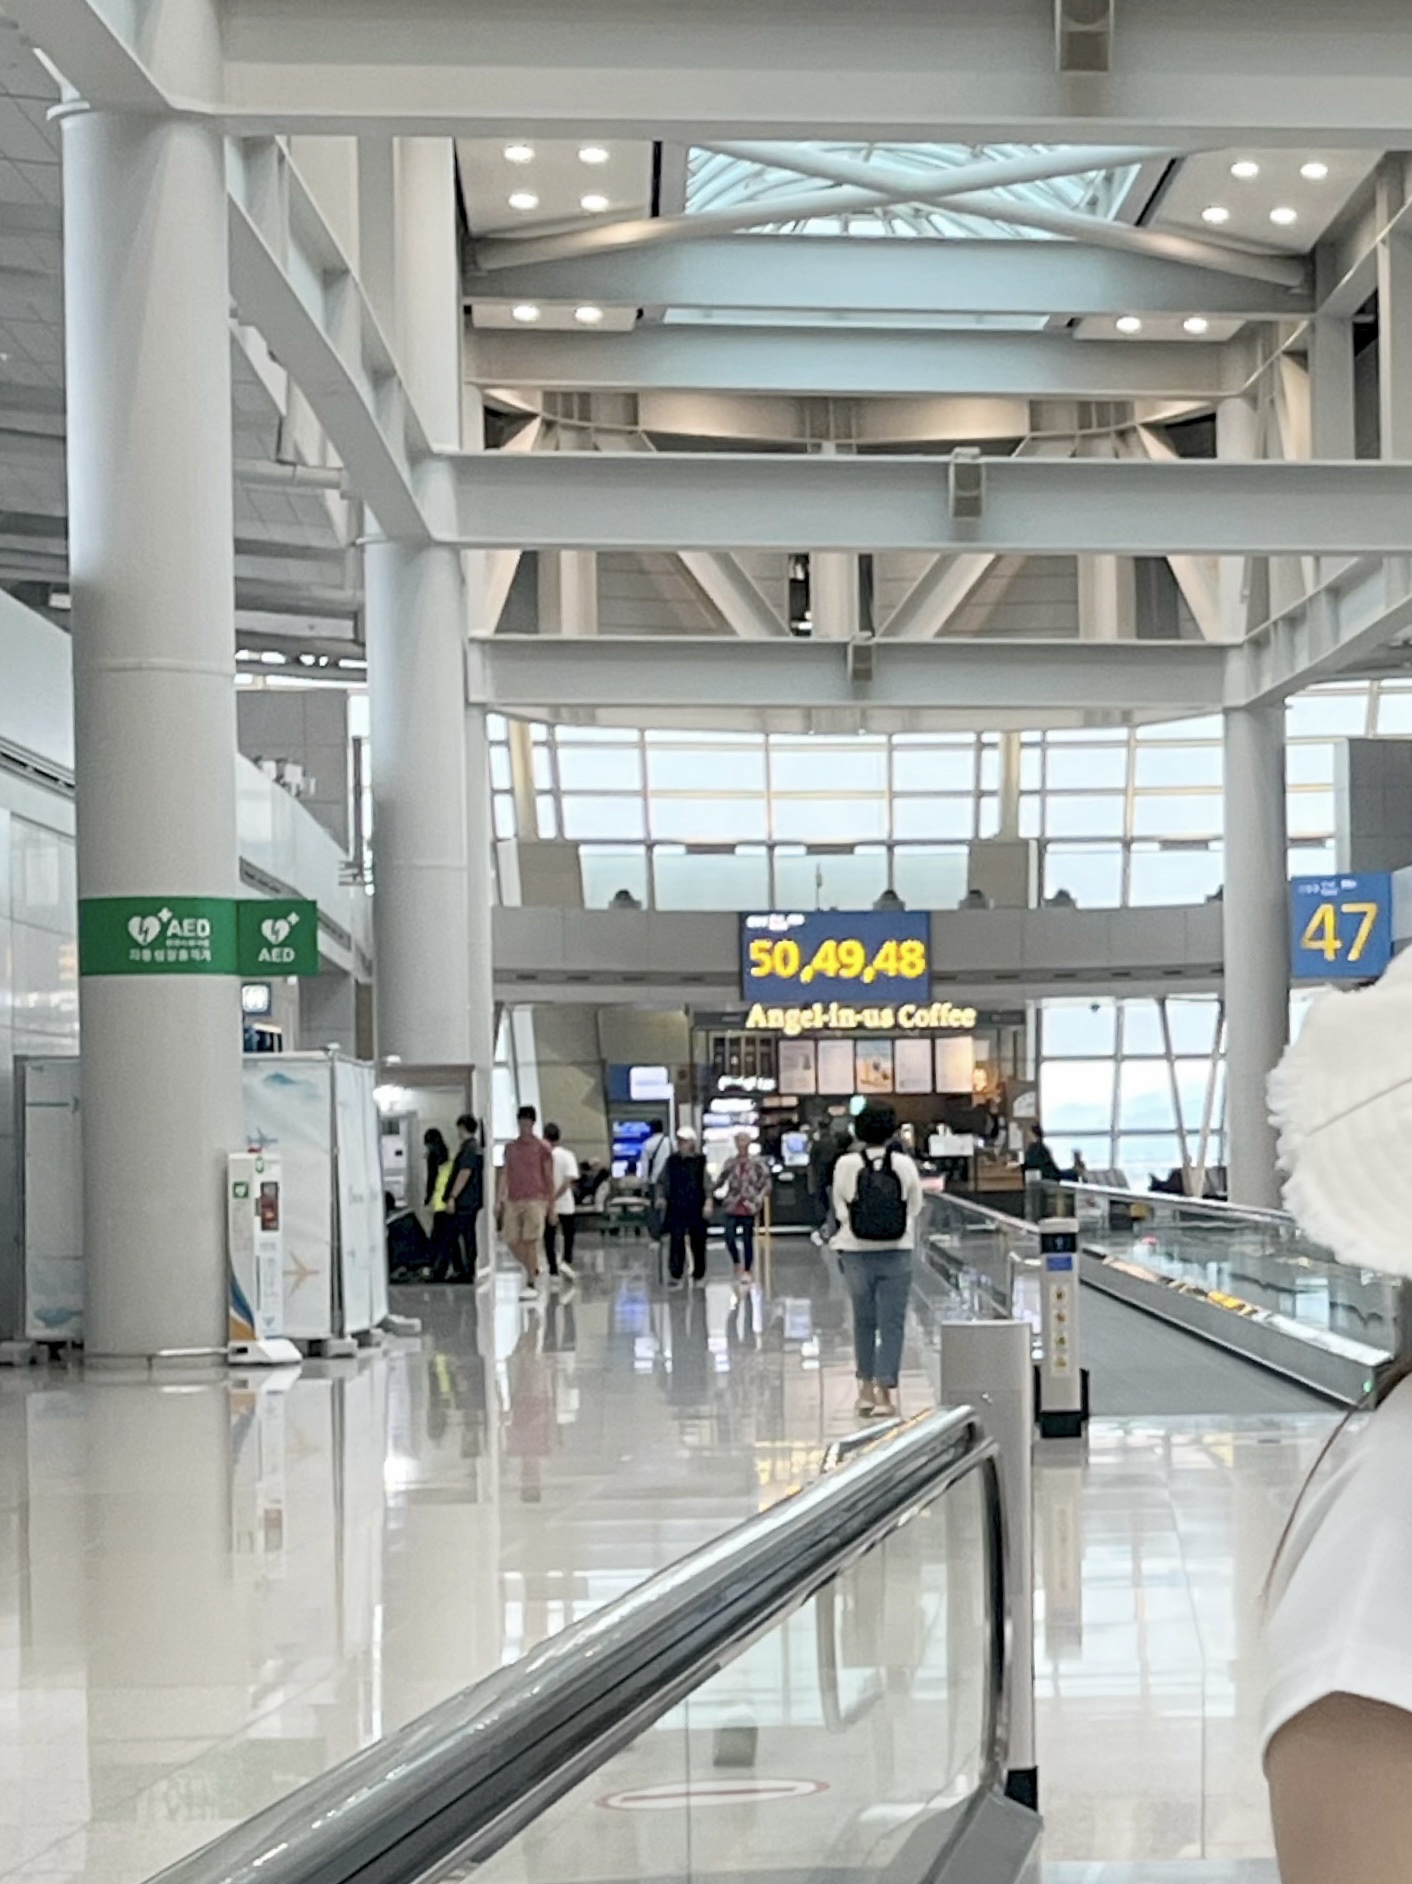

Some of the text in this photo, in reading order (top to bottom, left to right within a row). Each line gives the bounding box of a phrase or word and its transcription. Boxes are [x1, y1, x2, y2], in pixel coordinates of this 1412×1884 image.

[166, 918, 211, 937] AED
[1301, 902, 1377, 962] 47
[258, 946, 295, 963] AED
[749, 938, 926, 983] 50,49,48
[745, 1002, 977, 1036] Angel-in-us Coffee
